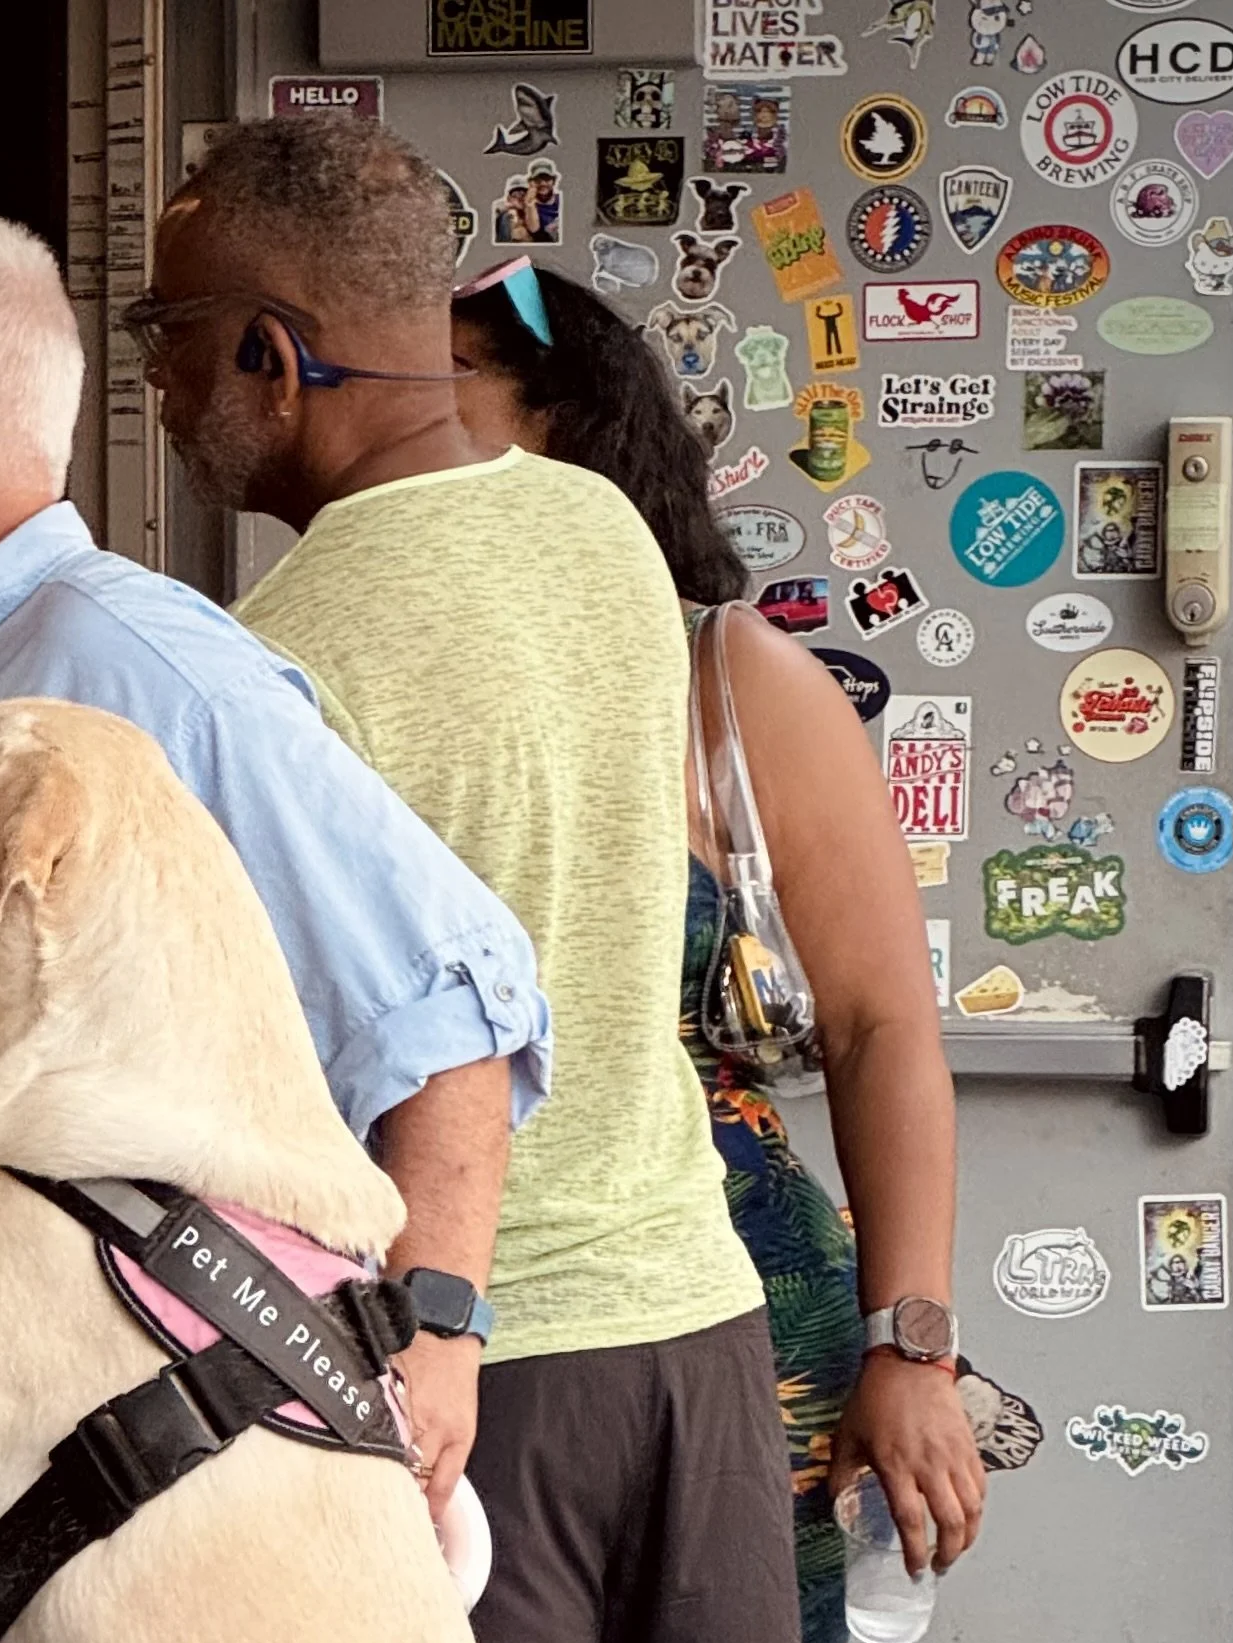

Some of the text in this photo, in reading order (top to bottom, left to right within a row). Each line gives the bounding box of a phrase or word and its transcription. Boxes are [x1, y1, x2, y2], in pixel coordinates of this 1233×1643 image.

[712, 11, 800, 37] LIVES
[711, 41, 840, 67] MATTER
[290, 87, 359, 104] HELLO
[1027, 75, 1123, 123] LOW TIDE
[1035, 138, 1130, 184] BREWING
[949, 179, 1002, 198] CANTEEN
[1005, 276, 1104, 307] MUSIC FESTIVAL
[869, 312, 973, 328] FLOCK SHOP
[1011, 338, 1062, 347] EVERY DAY
[1010, 358, 1025, 367] BIT
[884, 377, 991, 395] Let's Get
[881, 396, 990, 423] Strainge
[826, 498, 881, 521] DUCT TAPE
[968, 488, 1047, 567] LOW TIDE
[993, 515, 1041, 562] BREWING
[833, 543, 890, 568] CERTIFIED
[891, 745, 962, 778] ANDY'S
[892, 785, 960, 827] DELI
[995, 870, 1119, 917] FREAK
[172, 1225, 373, 1421] Pet Me Please
[1082, 1429, 1192, 1452] WICKED WEED
